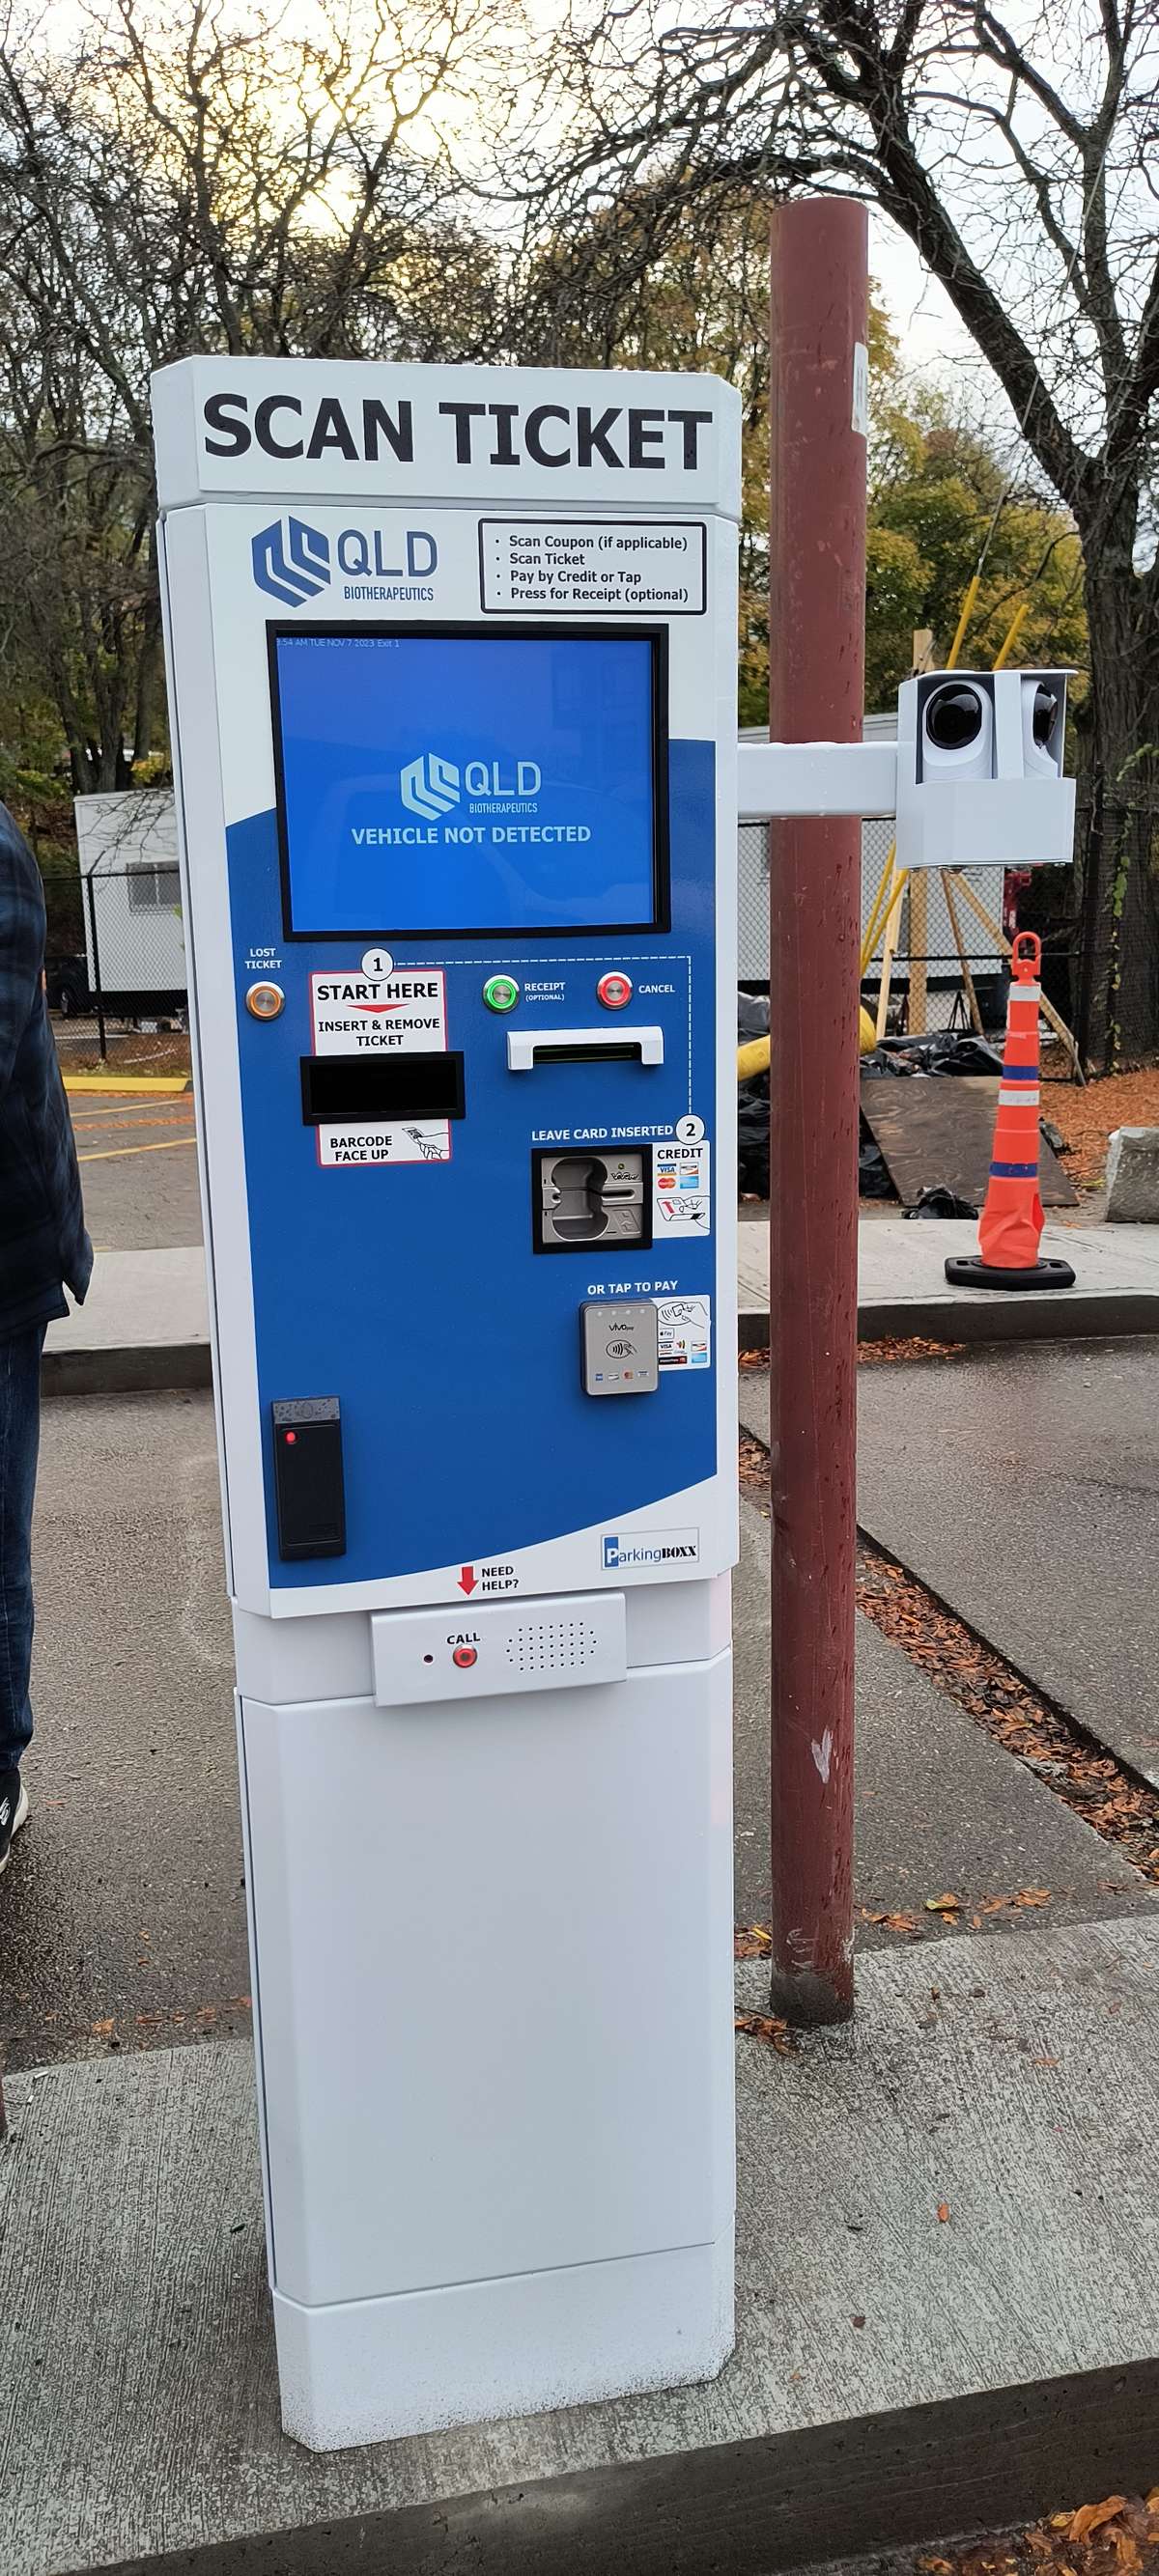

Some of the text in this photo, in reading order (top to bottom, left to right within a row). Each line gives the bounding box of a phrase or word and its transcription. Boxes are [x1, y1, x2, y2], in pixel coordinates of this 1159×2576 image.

[203, 393, 714, 470] SCAN TICKET
[509, 535, 688, 551] Scan Coupon (if applicable)
[338, 528, 438, 577] QLD
[510, 552, 585, 565] Scan Ticket
[511, 571, 641, 585] Pay by Credit or Tap
[343, 585, 435, 602] BIOTHERAPEUTICS
[511, 587, 689, 602] Press for Receipt (optional)
[465, 761, 542, 797] QLD
[469, 802, 538, 814] BIOTHERAPEUTICS
[352, 826, 591, 845] VEHICLE NOT DETECTED
[250, 948, 276, 958] LOST
[245, 959, 282, 969] TICKET
[374, 957, 383, 972] 1
[318, 983, 438, 1001] START HERE
[524, 982, 566, 992] RECEIPT
[638, 984, 675, 994] CANCEL
[525, 994, 565, 1002] (OPTIONAL)
[319, 1019, 440, 1032] INSERT & REMOVE
[356, 1035, 404, 1047] TICKET
[531, 1125, 674, 1141] LEAVE CARD INSERTED
[686, 1123, 696, 1137] 2
[330, 1135, 392, 1149] BARCODE
[335, 1150, 389, 1162] FACE UP
[657, 1148, 703, 1160] CREDIT
[587, 1280, 678, 1295] OR TAP TO PAY
[482, 1566, 514, 1578] NEED
[482, 1579, 520, 1591] HELP?
[446, 1633, 481, 1645] CALL
